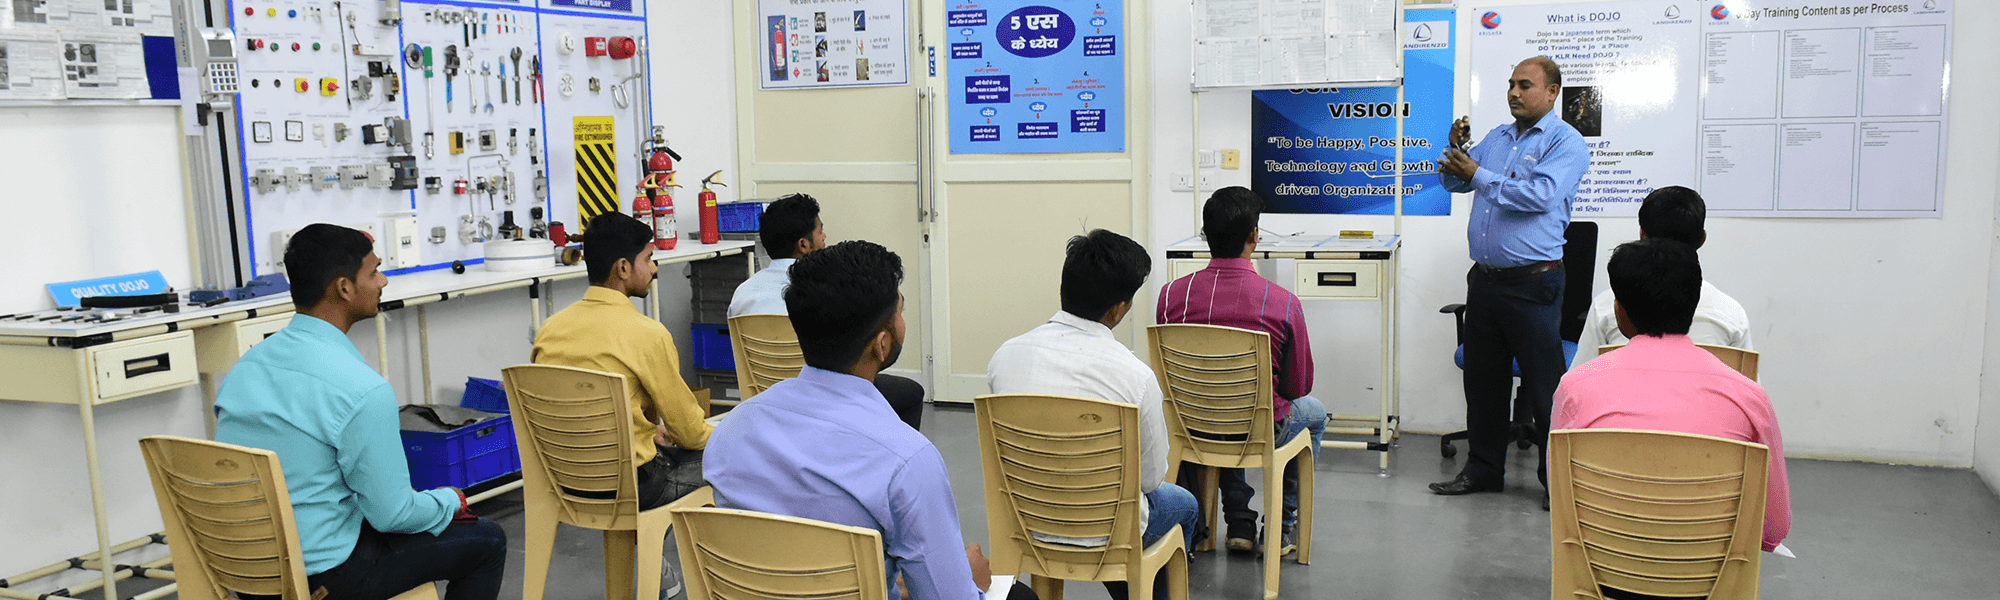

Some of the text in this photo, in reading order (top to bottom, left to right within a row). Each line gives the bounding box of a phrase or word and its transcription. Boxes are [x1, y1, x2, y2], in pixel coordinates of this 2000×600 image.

[1547, 11, 1621, 23] What is DOJO
[1763, 7, 1799, 19] Training
[1802, 5, 1838, 16] Content
[1840, 6, 1851, 15] as
[1853, 6, 1869, 16] per
[1871, 3, 1909, 13] Process
[1010, 14, 1060, 30] 5 एस
[1011, 35, 1059, 50] के ध्येय
[1616, 34, 1643, 42] Training
[1328, 102, 1411, 118] VISION
[1295, 136, 1314, 148] be
[1317, 136, 1365, 151] Happy,
[1369, 135, 1432, 150] Postive,
[1265, 160, 1347, 174] Technology
[1350, 160, 1377, 172] and
[1275, 183, 1320, 196] driven
[71, 279, 150, 299] QUALITY DOJO
